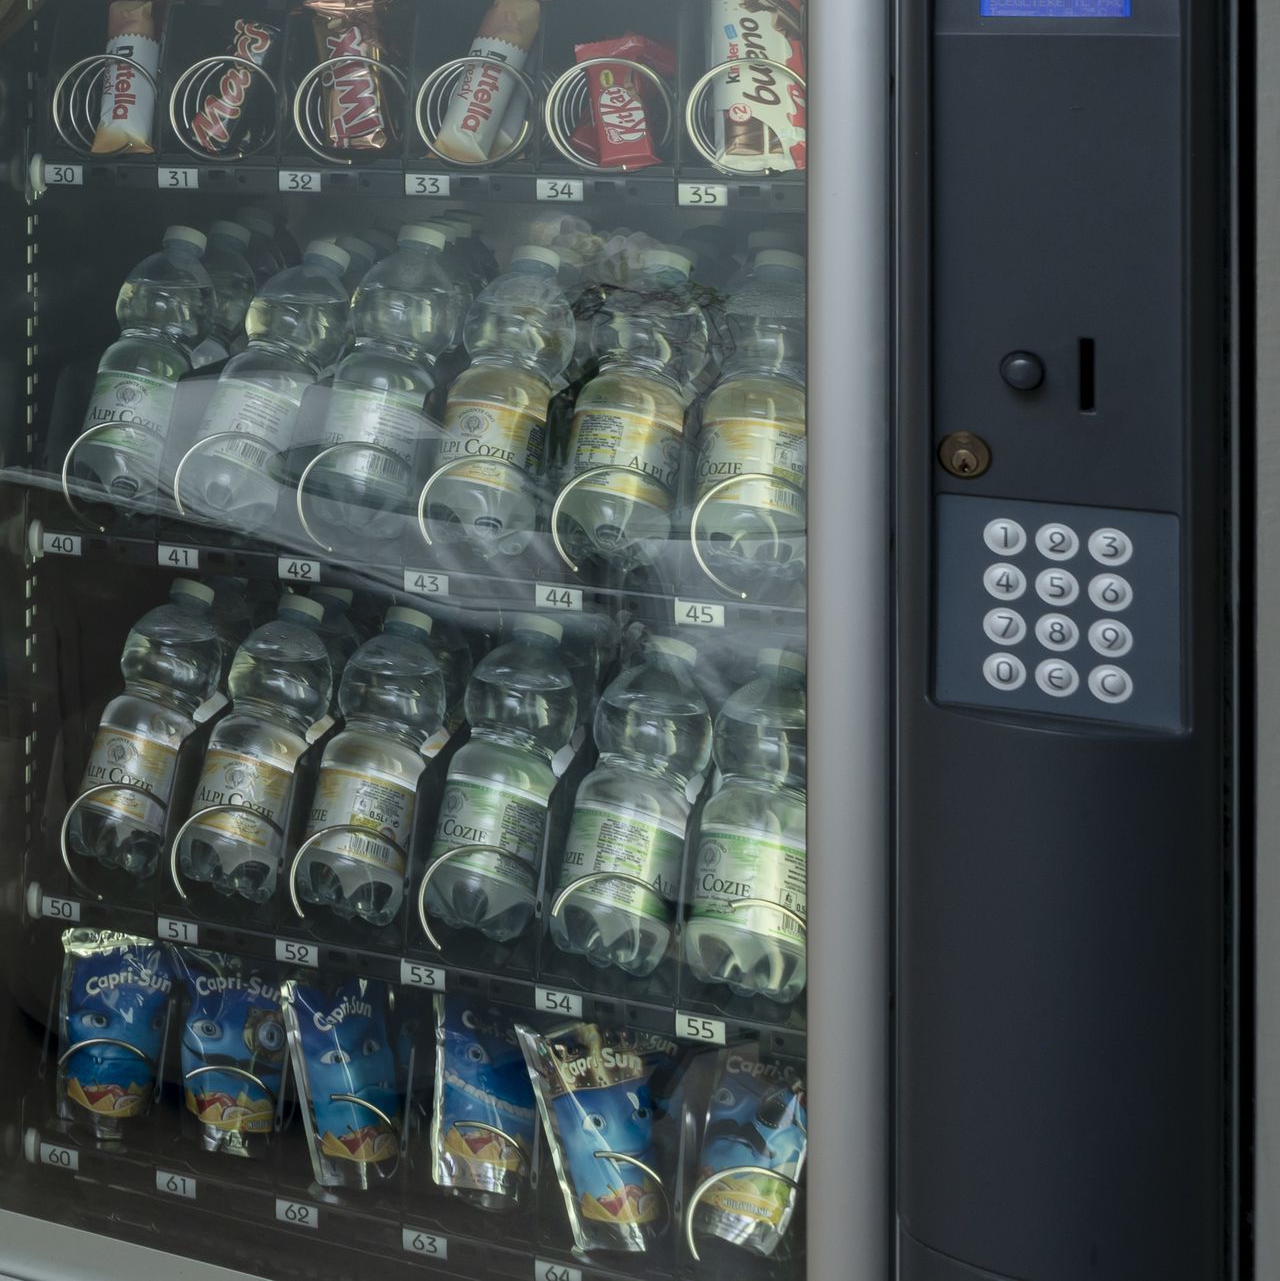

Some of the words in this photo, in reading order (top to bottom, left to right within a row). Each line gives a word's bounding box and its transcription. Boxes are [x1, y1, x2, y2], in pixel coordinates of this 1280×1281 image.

[739, 17, 781, 106] bueno
[191, 18, 271, 151] Mars
[456, 49, 482, 100] Bready
[326, 26, 383, 149] Twix
[460, 49, 508, 134] nutella
[599, 87, 647, 140] KitKat
[53, 167, 75, 183] 30
[168, 170, 188, 187] 31
[288, 173, 313, 191] 32
[415, 176, 440, 195] 33
[546, 182, 574, 199] 34
[689, 186, 717, 204] 35
[89, 406, 116, 422] ALPI
[464, 438, 515, 461] COZIE
[700, 460, 744, 477] COZIE
[51, 536, 74, 553] 40
[999, 526, 1009, 547] 1
[1049, 531, 1066, 553] 2
[1101, 536, 1118, 558] 3
[168, 549, 189, 567] 41
[287, 561, 313, 580] 42
[413, 574, 440, 593] 43
[996, 571, 1013, 592] 4
[1049, 576, 1065, 598] 5
[1101, 582, 1119, 604] 6
[545, 588, 573, 608] 44
[685, 605, 714, 624] 45
[997, 616, 1013, 638] 7
[1048, 621, 1066, 645] 8
[1102, 627, 1120, 649] 9
[996, 660, 1013, 683] 0
[1101, 673, 1118, 696] C
[109, 767, 153, 792] COZIE
[198, 786, 225, 804] ALPI
[228, 792, 274, 817] COZIE
[443, 818, 489, 844] COZIE
[702, 873, 752, 898] COZIE
[50, 899, 73, 919] 50
[168, 921, 188, 941] 51
[285, 943, 309, 964] 52
[85, 967, 172, 995] Capri-Sun
[410, 965, 436, 986] 53
[195, 972, 282, 1003] Capri-Sun
[545, 991, 572, 1013] 54
[312, 996, 373, 1031] Capri-Sun
[687, 1017, 714, 1039] 55
[560, 1048, 644, 1084] Capri-Sun
[48, 1148, 72, 1168] 60
[166, 1175, 187, 1195] 61
[284, 1204, 310, 1225] 62
[412, 1234, 438, 1254] 63
[544, 1265, 570, 1281] 64
